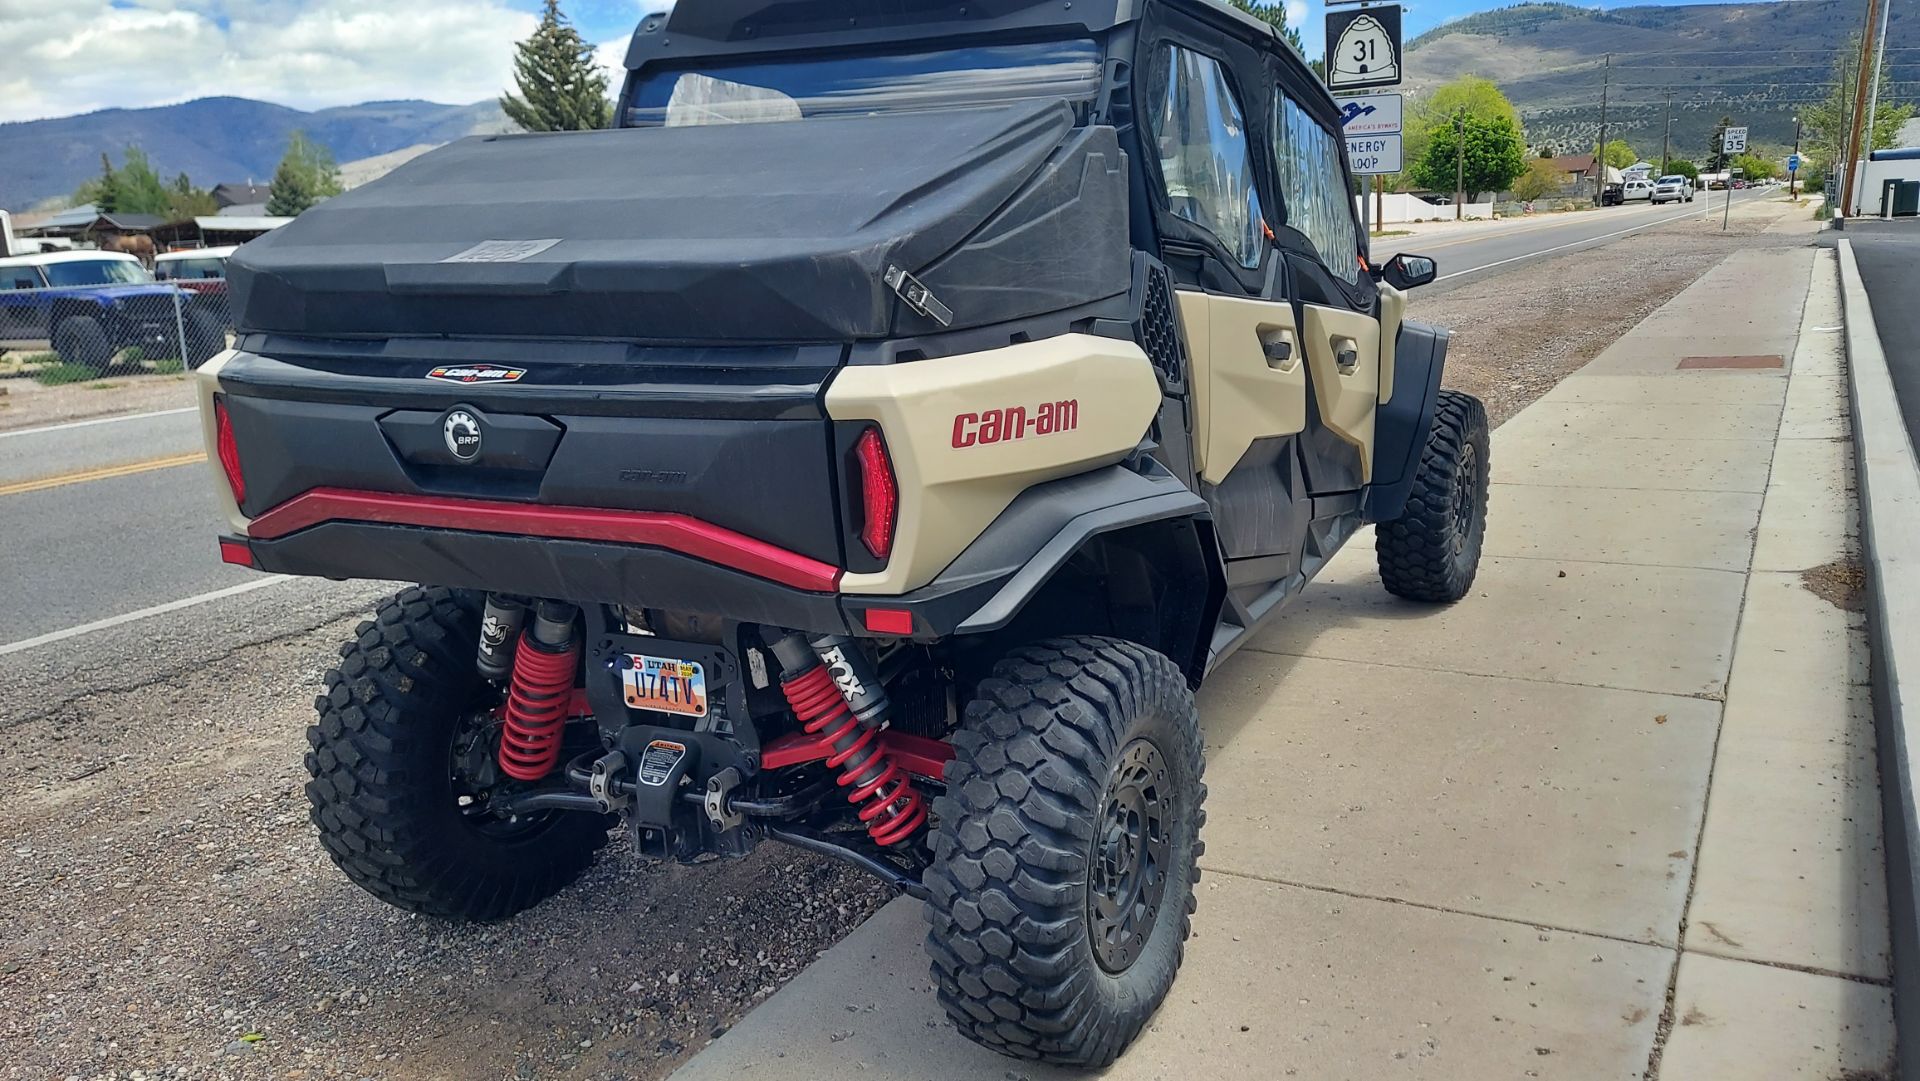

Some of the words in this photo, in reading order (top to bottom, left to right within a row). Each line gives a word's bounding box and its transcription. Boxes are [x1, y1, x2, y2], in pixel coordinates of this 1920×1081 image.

[1353, 39, 1375, 62] 31
[1348, 123, 1376, 131] AMERICA'S
[1345, 140, 1386, 153] ENERGY
[1726, 140, 1745, 151] 35
[1352, 157, 1379, 169] LOOP
[951, 399, 1079, 449] can-am
[458, 436, 479, 445] BRP
[633, 656, 644, 670] 5
[647, 660, 676, 672] UTAH
[820, 645, 867, 702] FOX
[635, 671, 693, 705] U74TV
